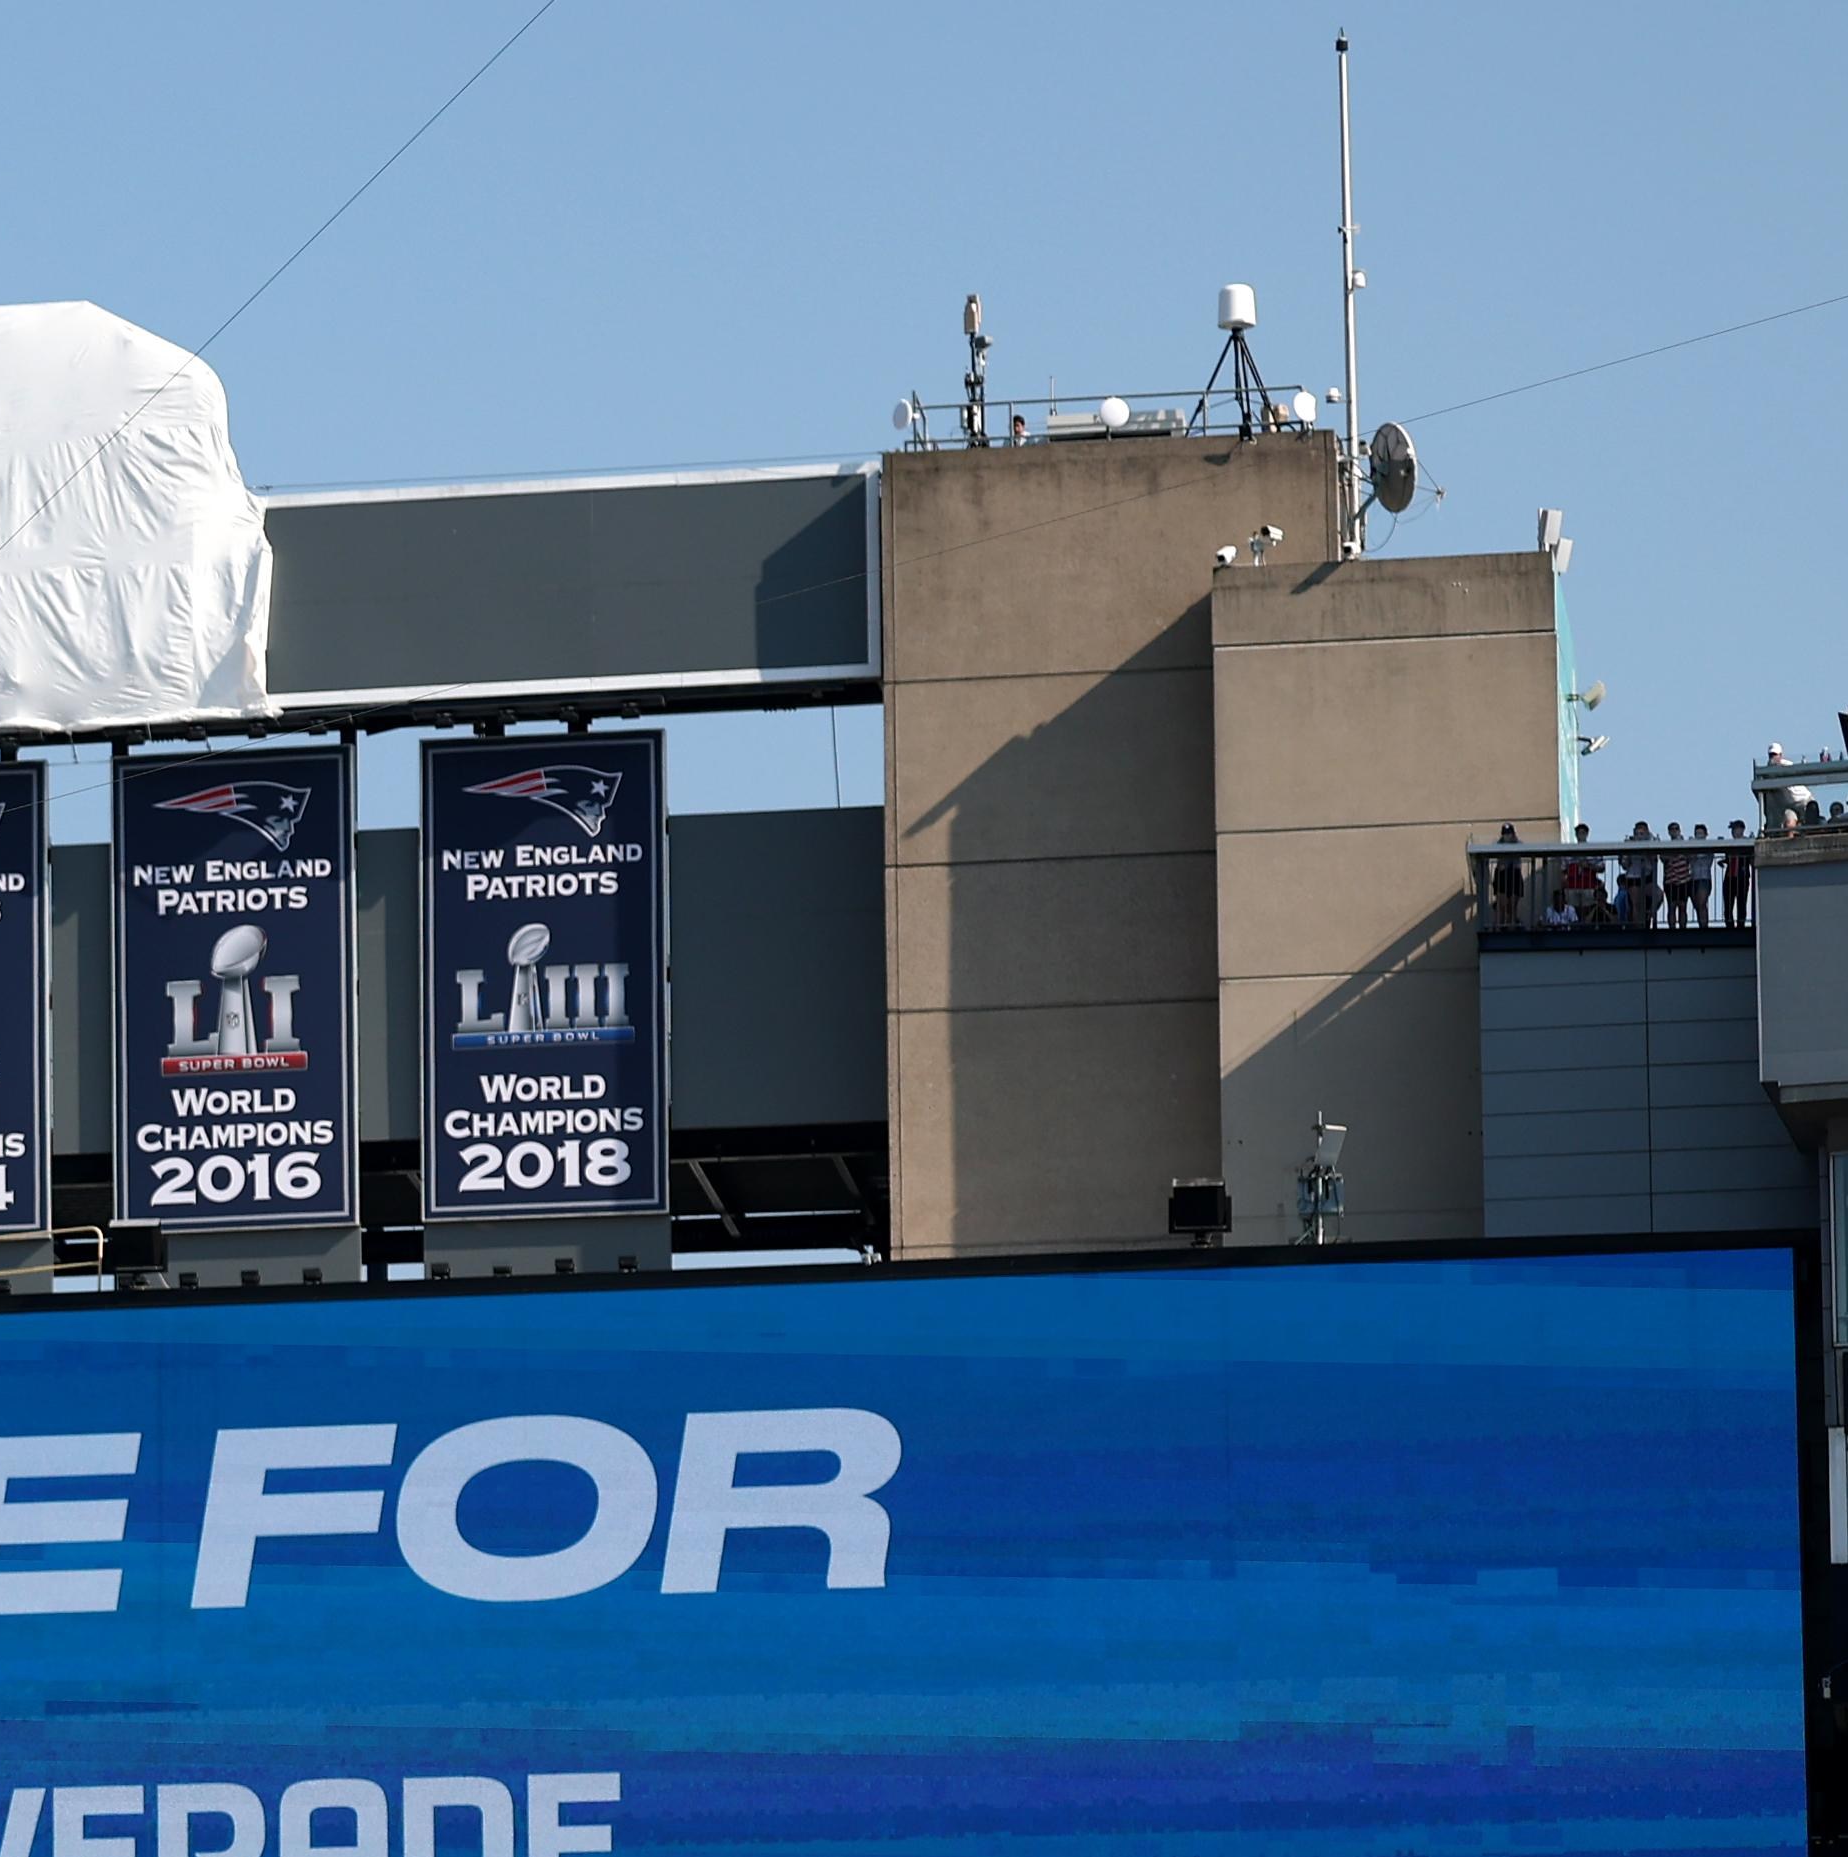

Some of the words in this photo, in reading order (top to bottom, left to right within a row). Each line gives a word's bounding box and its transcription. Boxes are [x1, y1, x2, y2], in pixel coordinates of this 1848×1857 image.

[133, 861, 194, 886] NEW
[205, 857, 332, 883] ENGLAND
[441, 848, 503, 873] NEW
[516, 842, 644, 868] ENGLAND
[156, 884, 309, 916] PATRIOTS
[466, 870, 620, 901] PATRIOTS
[486, 1032, 542, 1046] SUPER
[549, 1028, 601, 1043] BOWL
[178, 1059, 233, 1073] SUPER
[241, 1056, 291, 1070] BOWL
[172, 1087, 297, 1117] WORLD
[479, 1073, 607, 1105] WORLD
[137, 1119, 334, 1152] CHAMPIONS
[444, 1106, 645, 1138] CHAMPIONS
[150, 1152, 322, 1207] 2016
[458, 1139, 633, 1193] 2018
[191, 1407, 902, 1611] FOR
